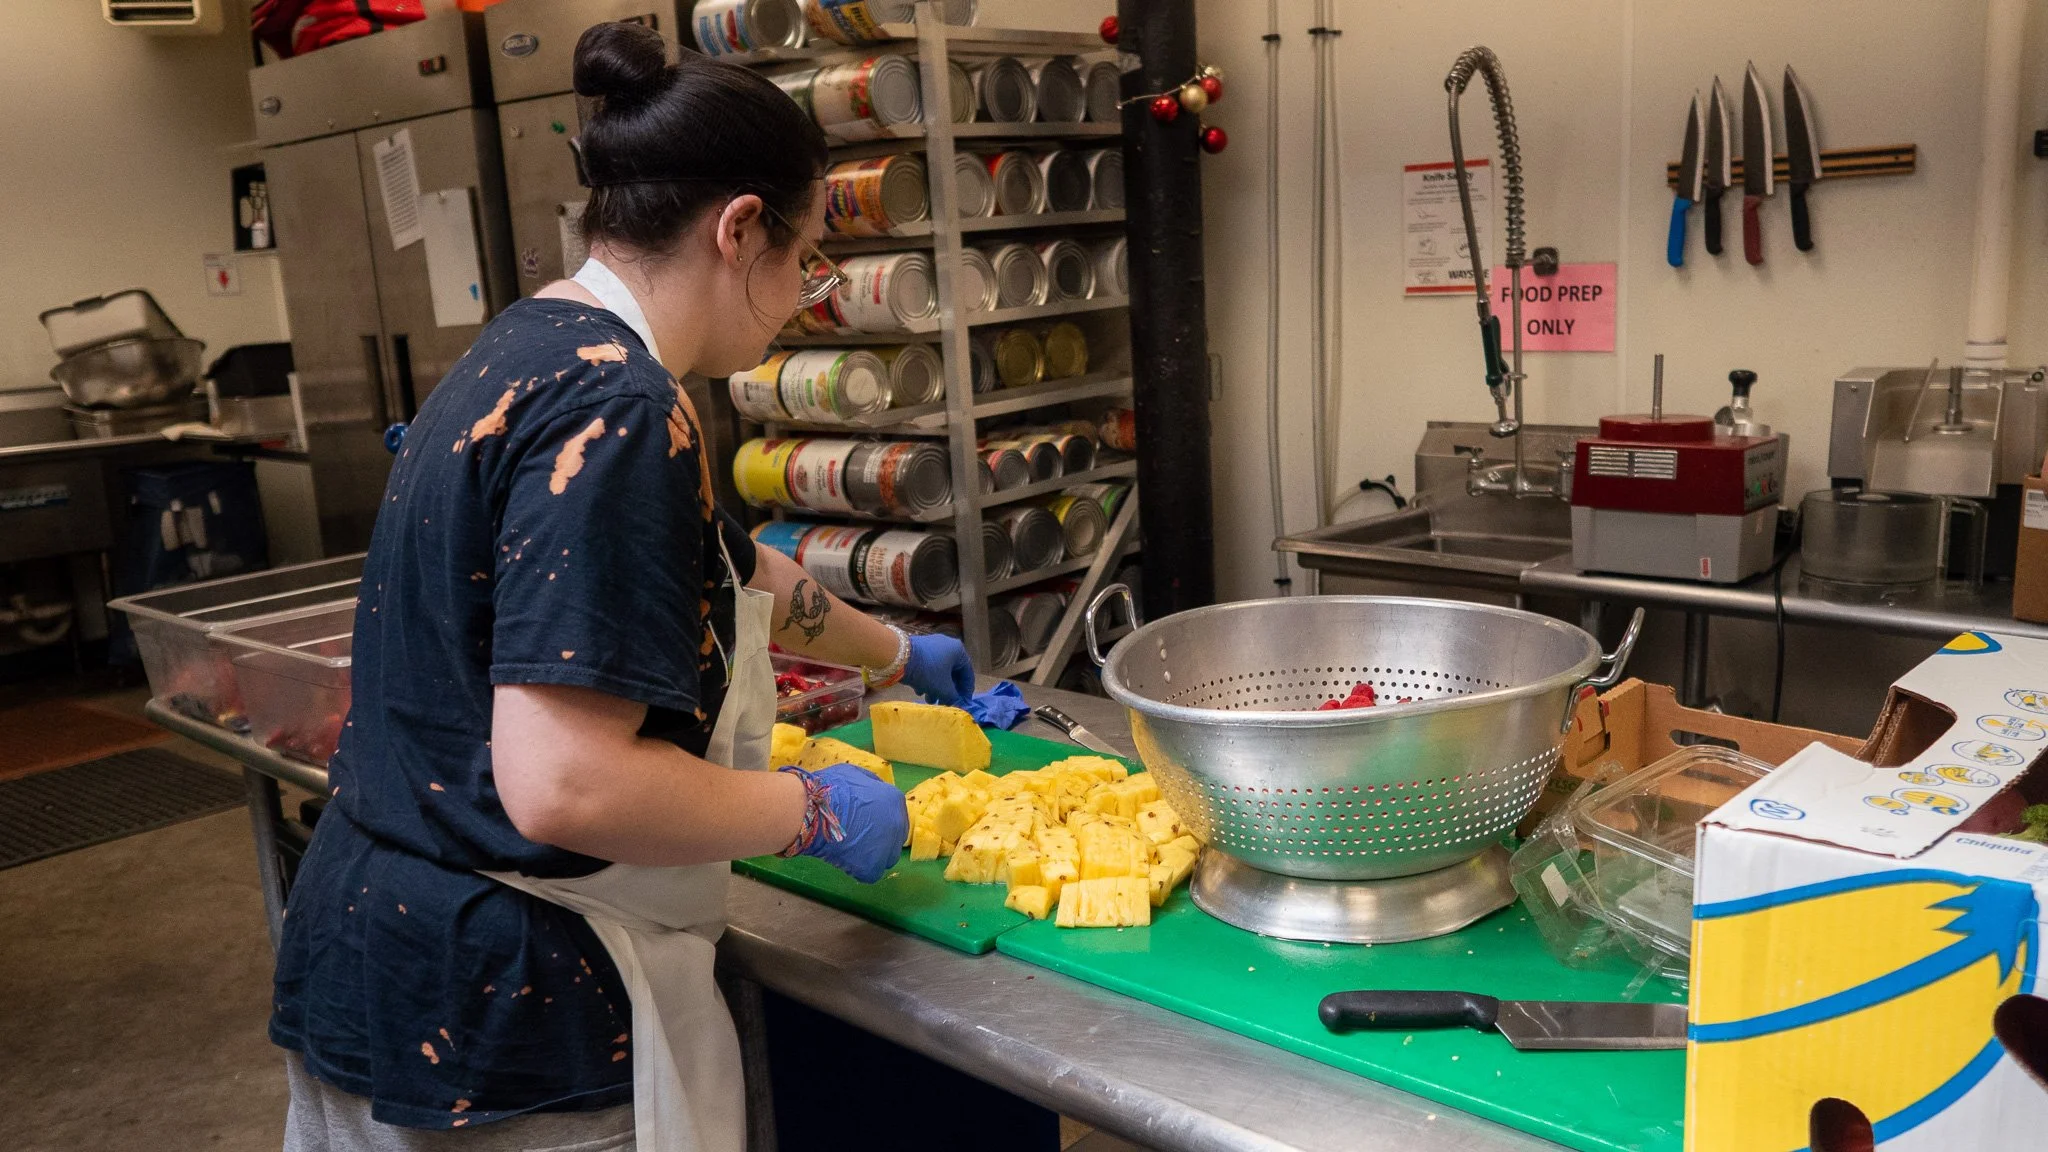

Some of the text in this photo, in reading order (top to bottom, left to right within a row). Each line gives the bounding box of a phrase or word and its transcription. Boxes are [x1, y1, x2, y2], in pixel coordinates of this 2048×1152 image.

[1423, 171, 1474, 181] Knife Saty
[1448, 269, 1489, 279] WAYSE
[1558, 285, 1602, 302] PREP
[1527, 319, 1575, 335] ONLY
[1956, 837, 2034, 855] Chiquita
